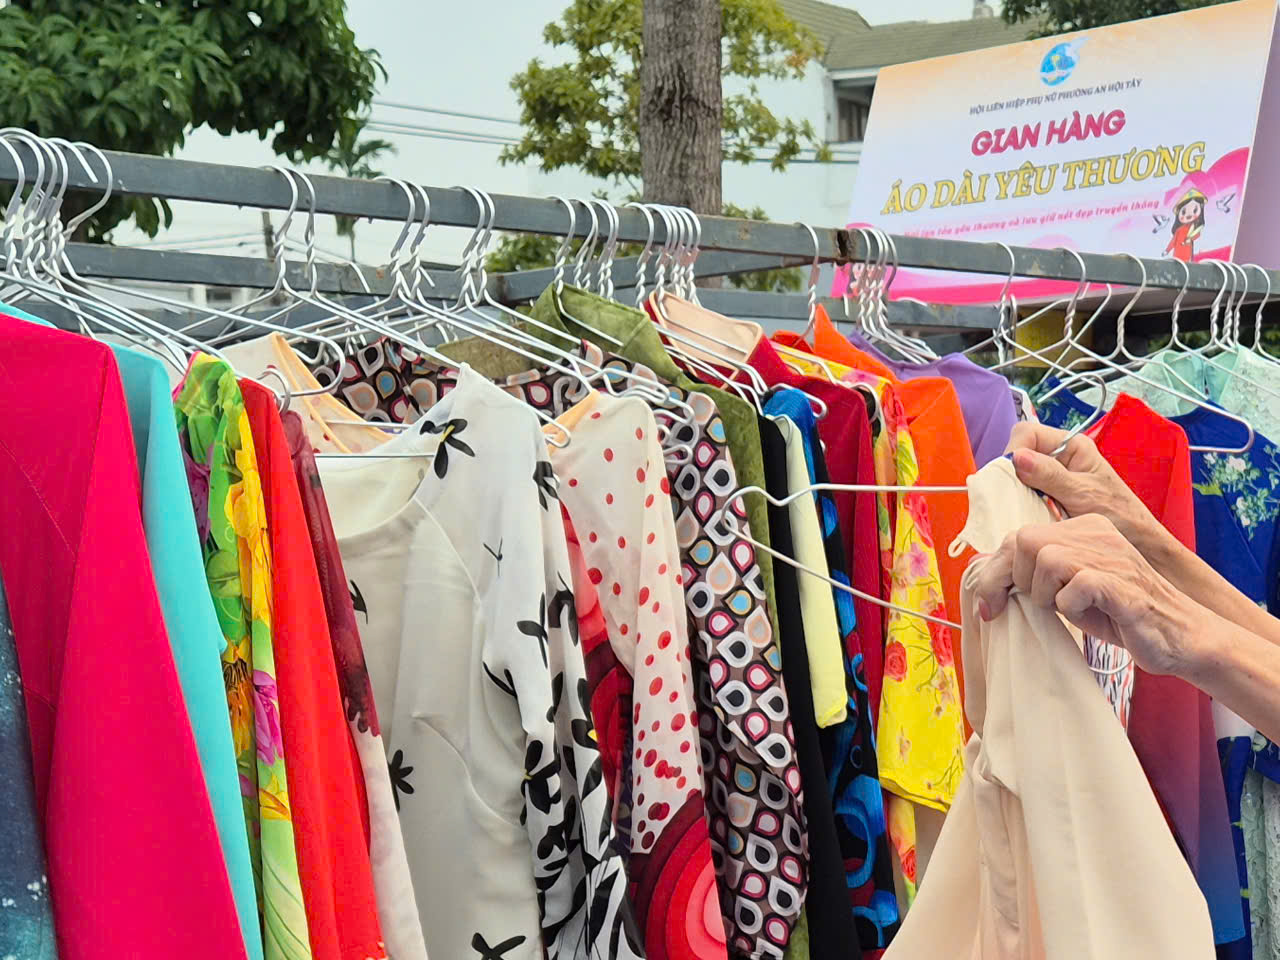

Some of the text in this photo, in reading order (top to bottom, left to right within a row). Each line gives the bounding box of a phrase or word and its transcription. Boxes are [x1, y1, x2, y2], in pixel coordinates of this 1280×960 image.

[1094, 84, 1106, 95] AN
[971, 109, 1127, 157] GIAN HÀNG
[880, 141, 1207, 215] ÁO DÀI YÊU THƯƠNG
